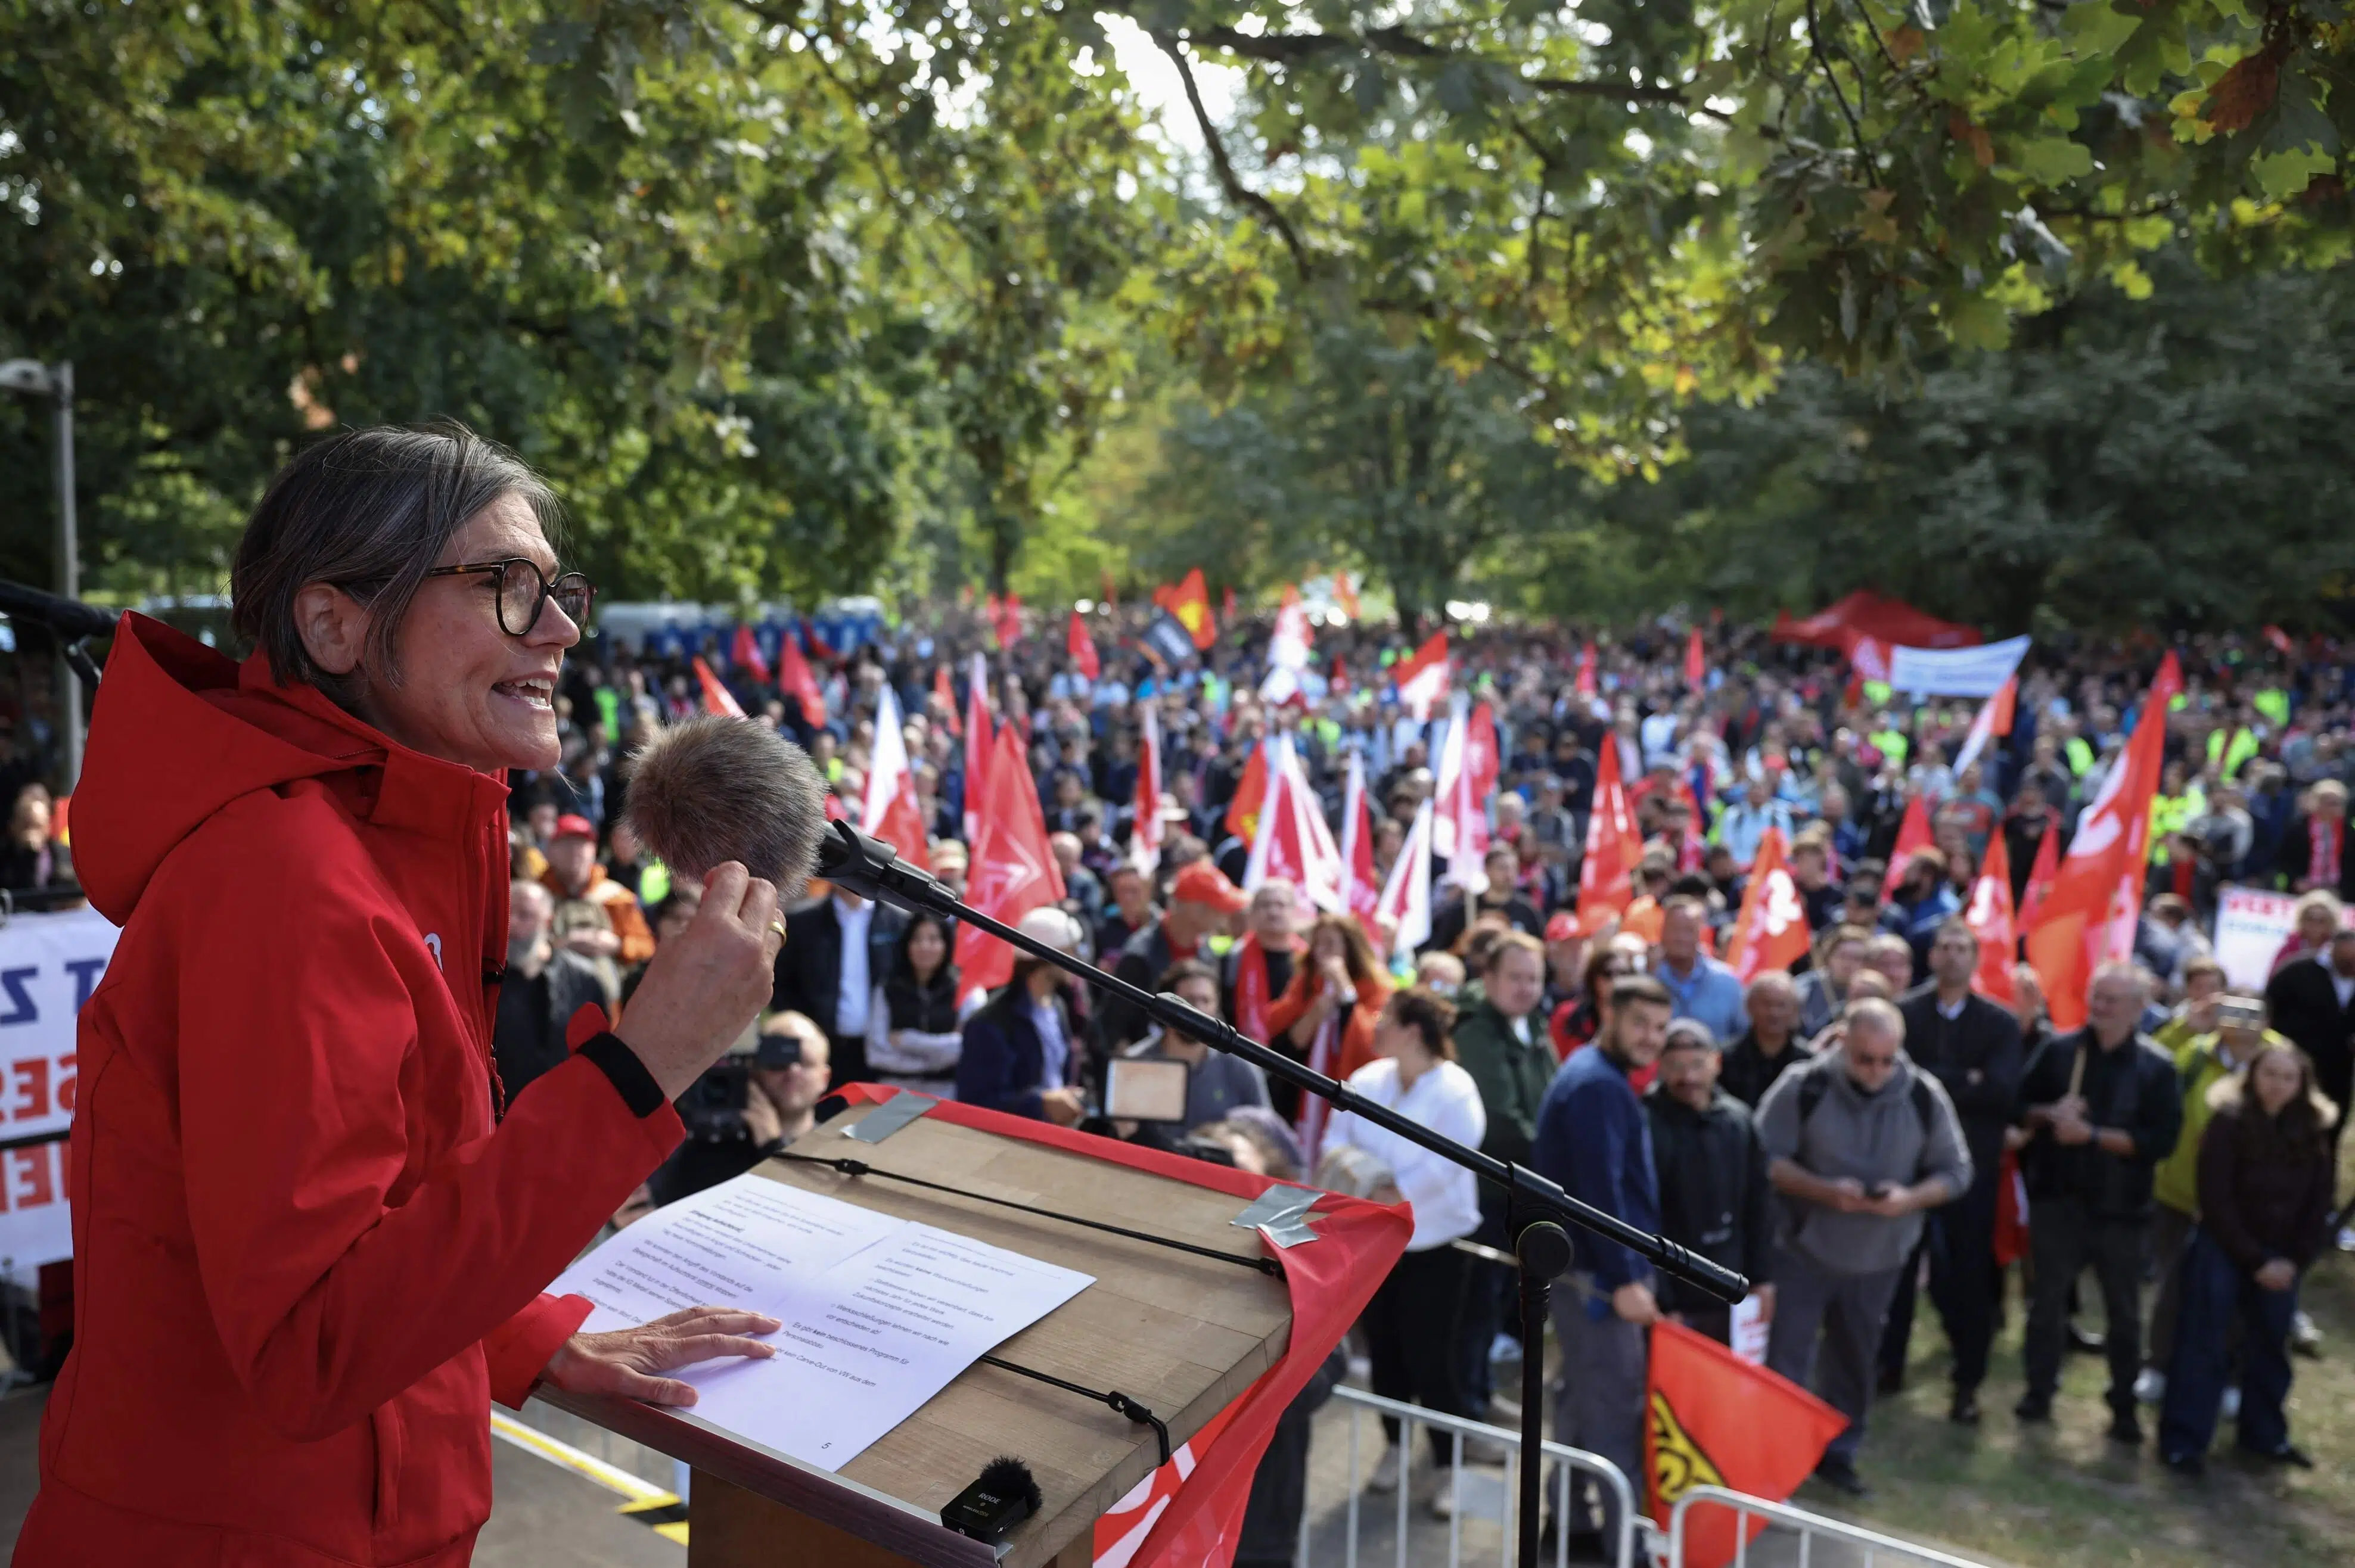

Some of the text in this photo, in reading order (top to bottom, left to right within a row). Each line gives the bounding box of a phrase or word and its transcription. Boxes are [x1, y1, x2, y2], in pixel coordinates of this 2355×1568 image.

[835, 1317, 871, 1331] entschieden
[836, 1304, 892, 1326] Werksschließungen
[891, 1323, 912, 1333] lehnen
[812, 1329, 827, 1337] kein
[825, 1334, 868, 1351] beschlossenes
[867, 1347, 900, 1362] Programm
[796, 1355, 828, 1369] Carve-Out
